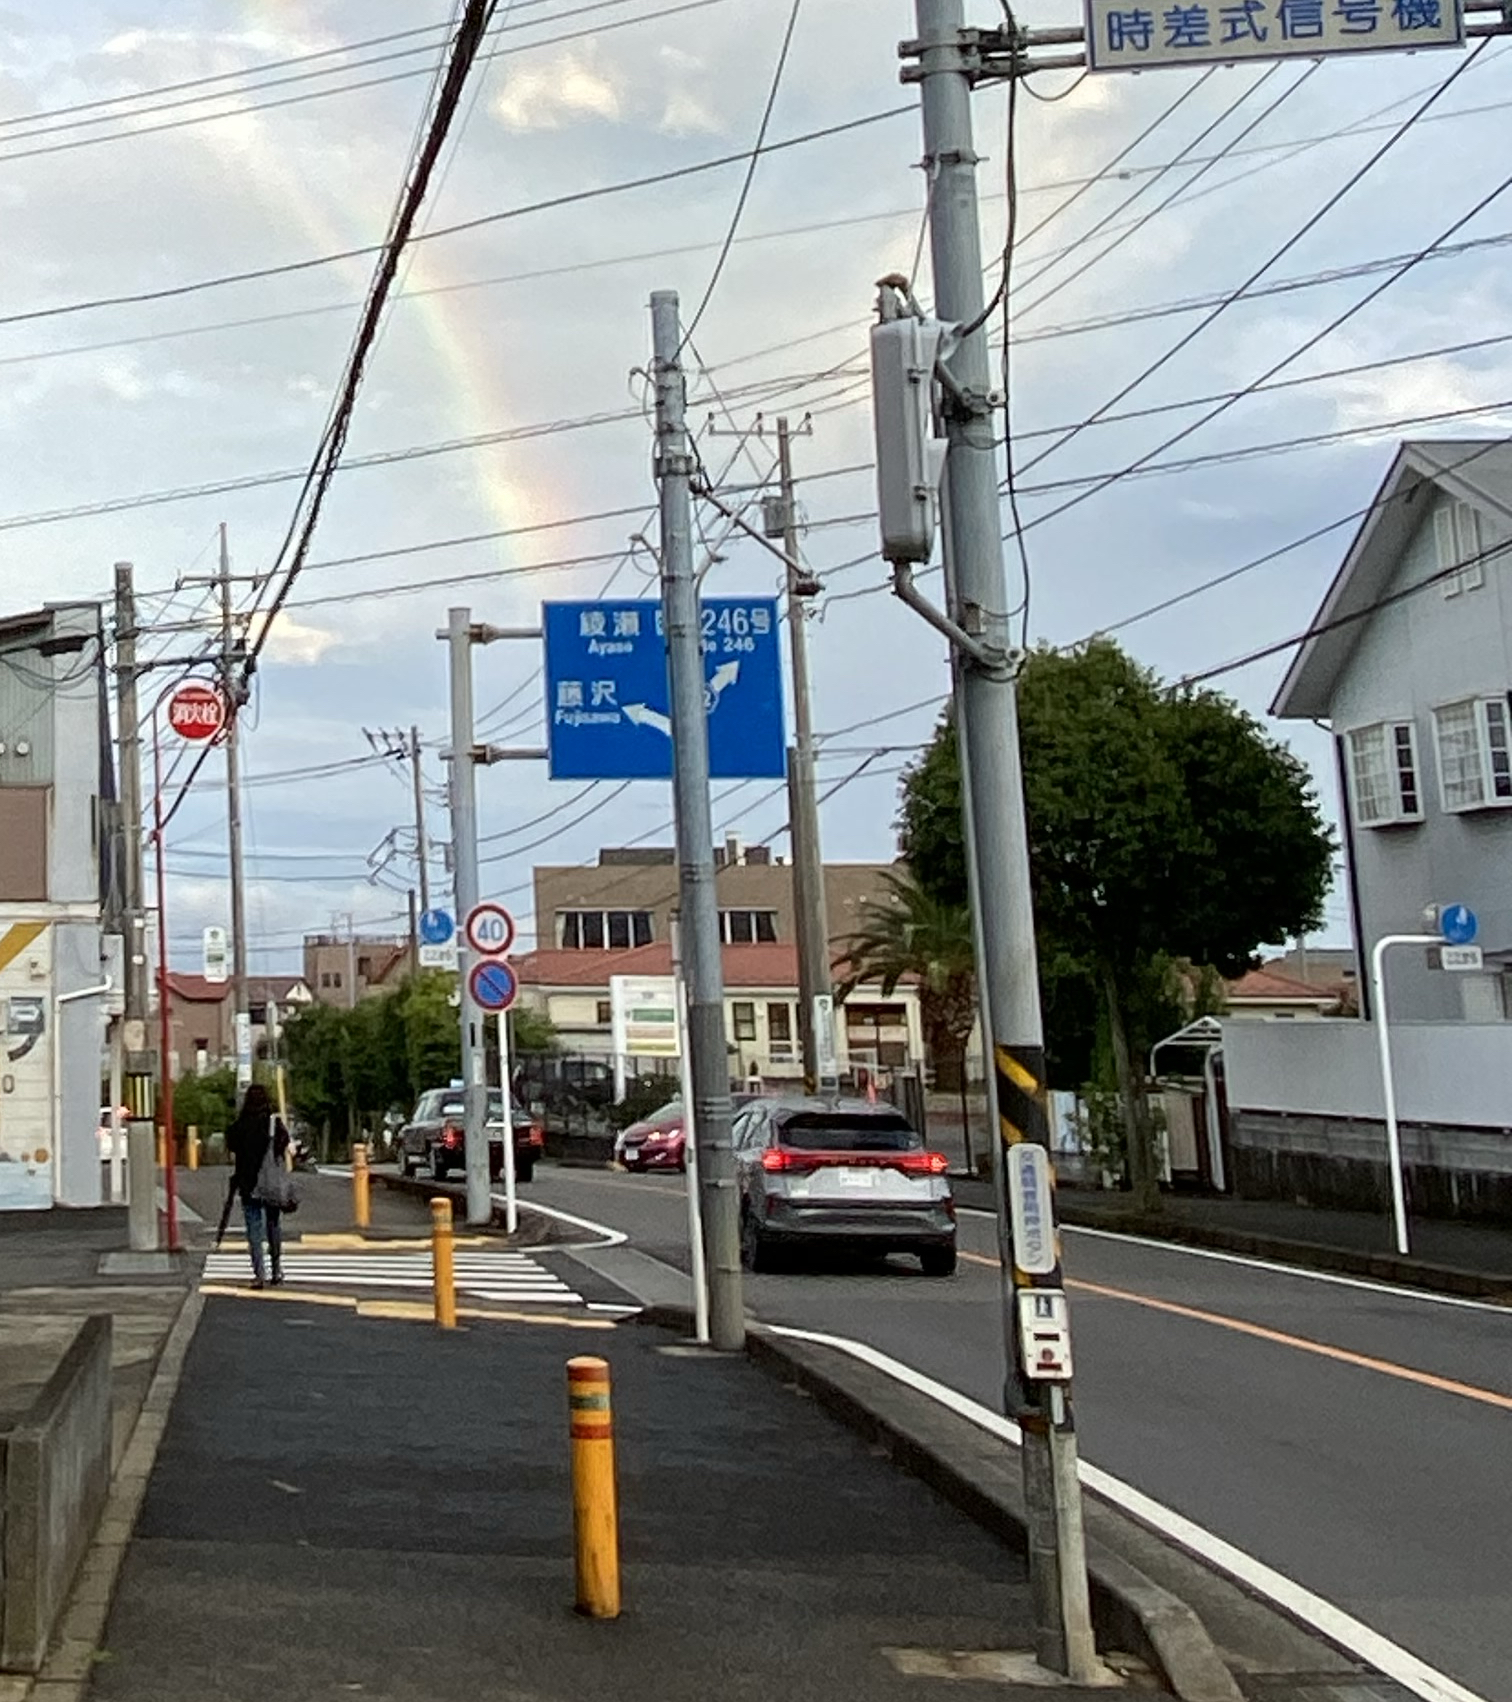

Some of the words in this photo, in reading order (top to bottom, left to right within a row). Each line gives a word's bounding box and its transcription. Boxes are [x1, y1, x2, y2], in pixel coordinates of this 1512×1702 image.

[1106, 0, 1442, 52] 時差式信号機
[580, 610, 640, 636] 綾瀬
[587, 638, 634, 657] Ayase
[723, 637, 755, 652] 246
[556, 680, 618, 707] 藤沢
[172, 702, 218, 725] 消火栓
[554, 710, 622, 727] Fujisawa
[477, 918, 504, 941] 40
